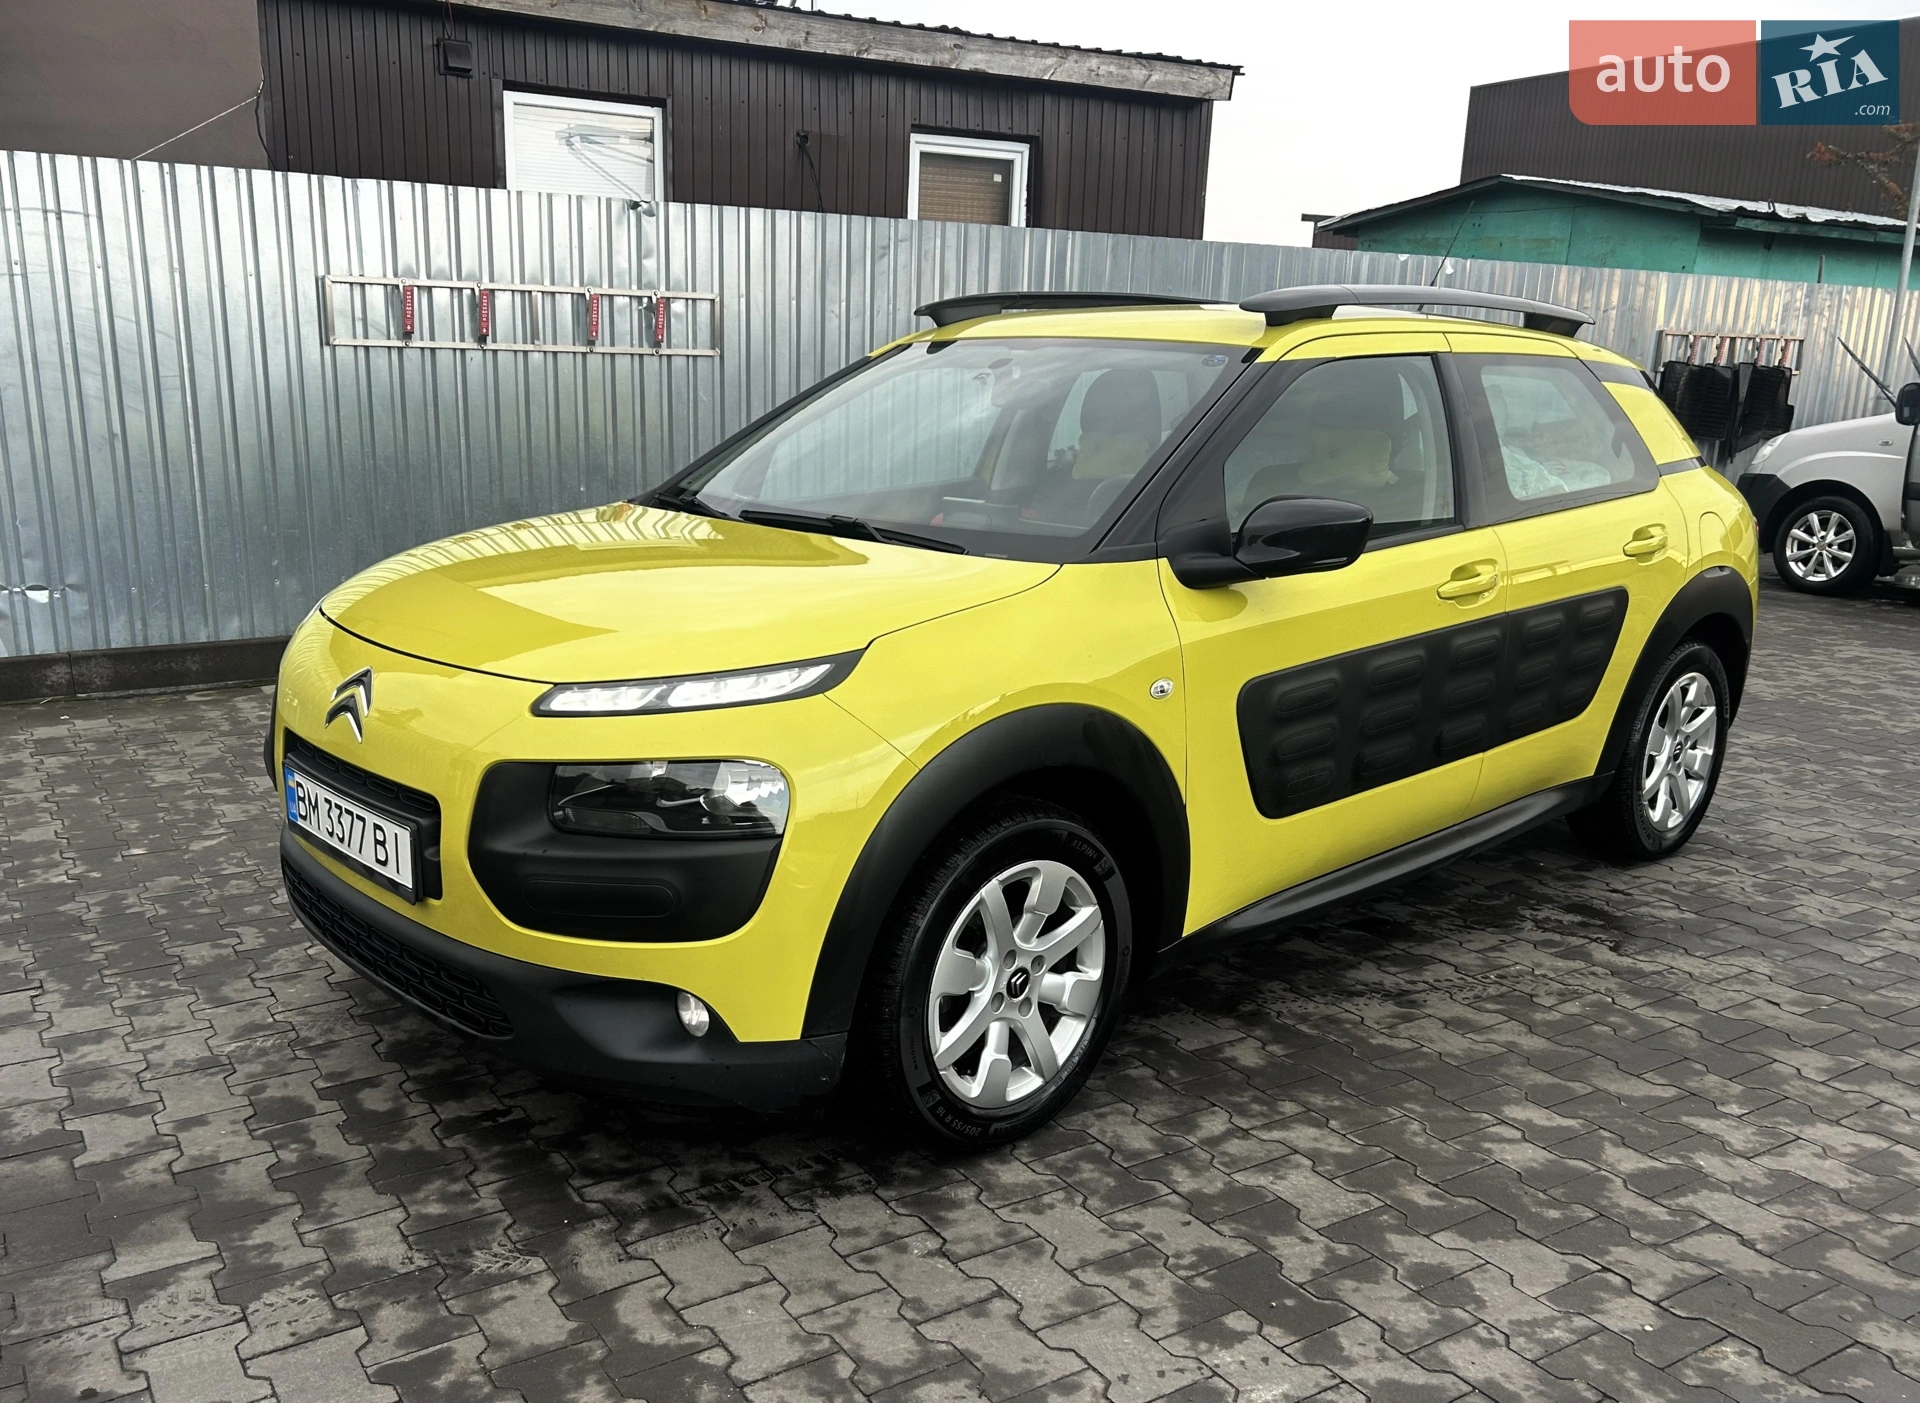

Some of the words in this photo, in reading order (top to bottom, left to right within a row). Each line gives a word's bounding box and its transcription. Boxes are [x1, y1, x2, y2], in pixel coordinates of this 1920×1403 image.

[295, 779, 321, 832] BM
[323, 796, 367, 855] 3377
[372, 821, 401, 876] BI
[935, 1105, 947, 1118] 16
